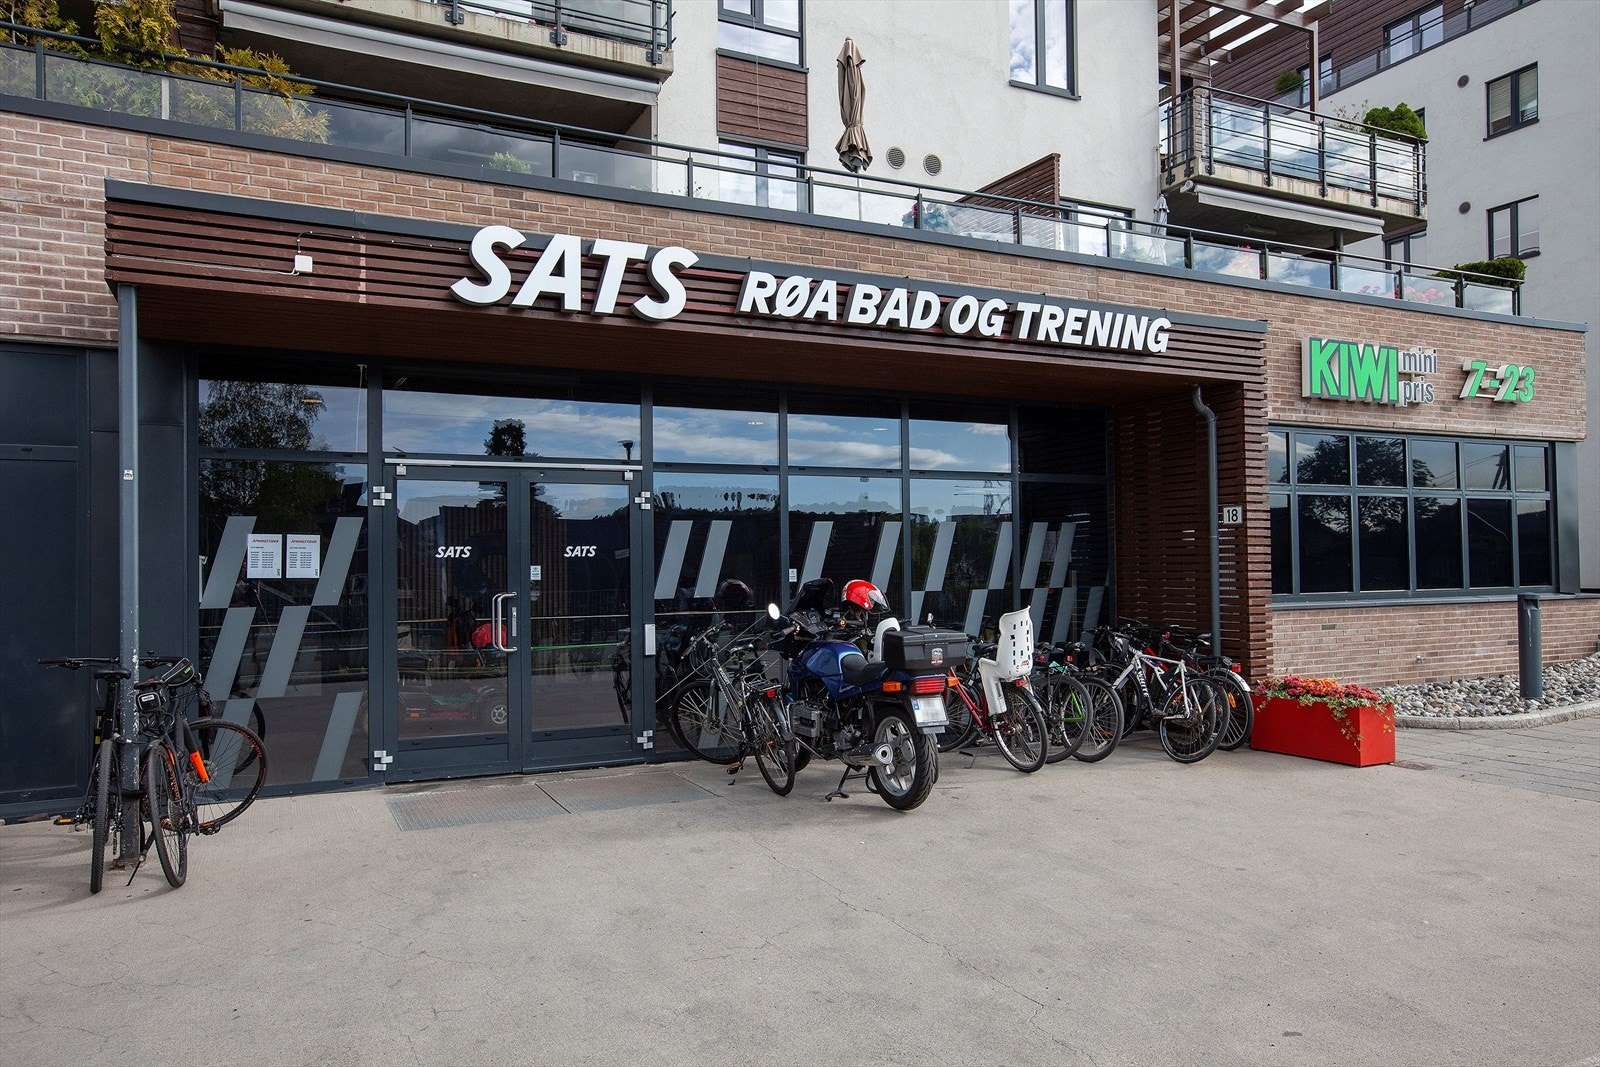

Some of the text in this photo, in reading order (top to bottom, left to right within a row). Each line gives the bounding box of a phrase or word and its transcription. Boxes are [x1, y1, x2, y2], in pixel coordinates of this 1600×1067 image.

[451, 225, 699, 321] SATS
[739, 270, 1170, 354] RØA BAD OG TRENING
[1307, 337, 1399, 403] KIWI
[1402, 347, 1438, 374] mini
[1402, 376, 1435, 407] pris
[1465, 358, 1536, 403] 7-23
[1227, 508, 1239, 522] 18
[435, 545, 472, 558] SATS
[563, 545, 597, 557] SATS
